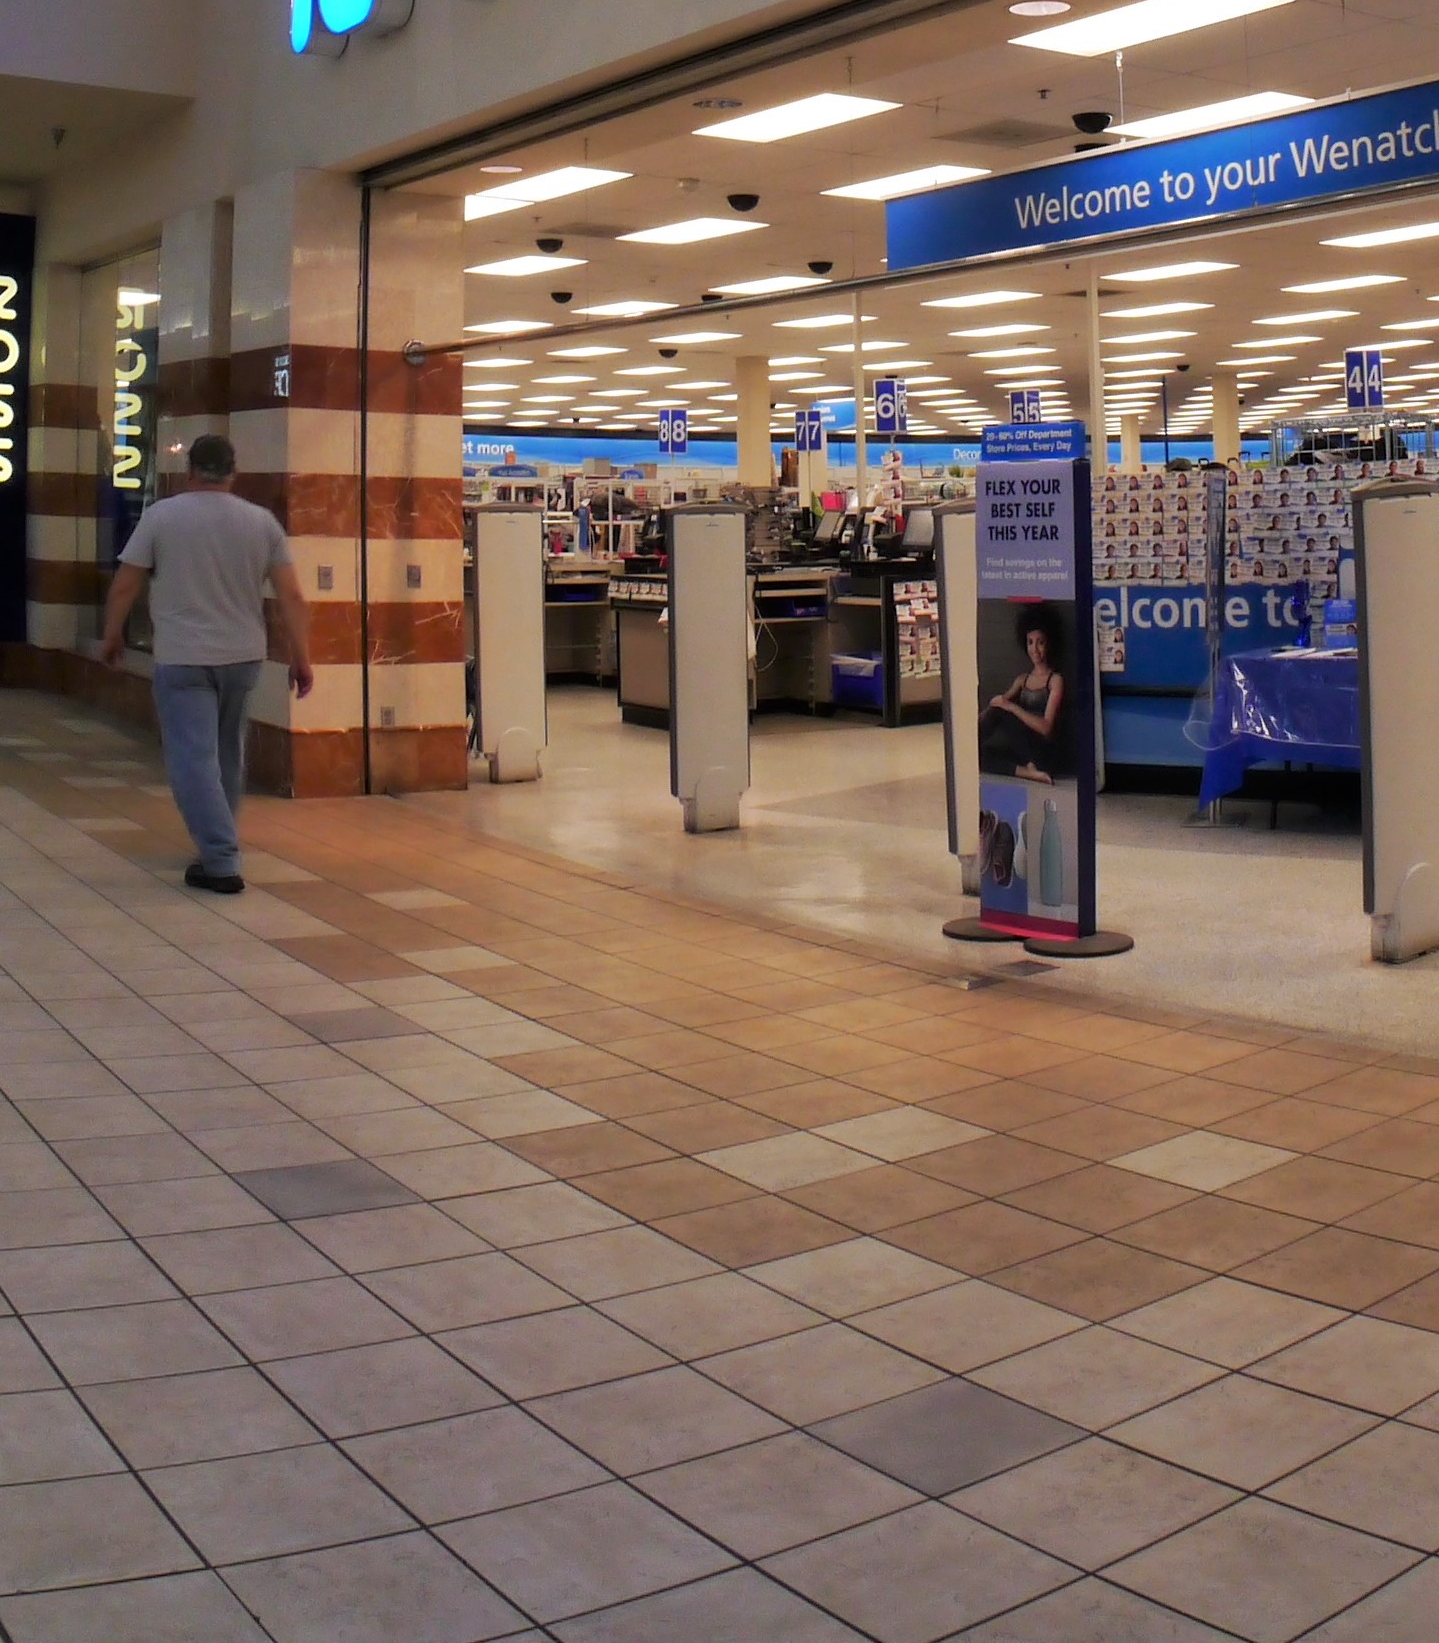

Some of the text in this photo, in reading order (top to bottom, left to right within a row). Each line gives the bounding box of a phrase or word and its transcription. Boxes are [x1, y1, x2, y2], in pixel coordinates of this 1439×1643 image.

[1014, 180, 1151, 230] Welcome
[1159, 169, 1195, 203] to
[1204, 150, 1281, 205] your
[1348, 365, 1363, 393] 4
[1368, 364, 1380, 392] 4
[877, 394, 895, 419] 6
[1013, 403, 1024, 424] 5
[1028, 402, 1039, 423] 5
[660, 420, 669, 442] 8
[672, 419, 686, 442] 8
[796, 421, 805, 441] 7
[809, 421, 820, 441] 7
[1015, 429, 1028, 440] Off
[1028, 428, 1072, 440] Department
[477, 442, 515, 455] more
[986, 444, 1006, 454] Store
[1033, 441, 1055, 453] Every
[1056, 440, 1072, 452] Day
[985, 479, 1061, 496] FLEX YOUR
[991, 502, 1056, 519] BEST SELF
[988, 525, 1060, 541] THIS YEAR
[986, 558, 1062, 568] Find savings on the
[1013, 571, 1037, 580] active
